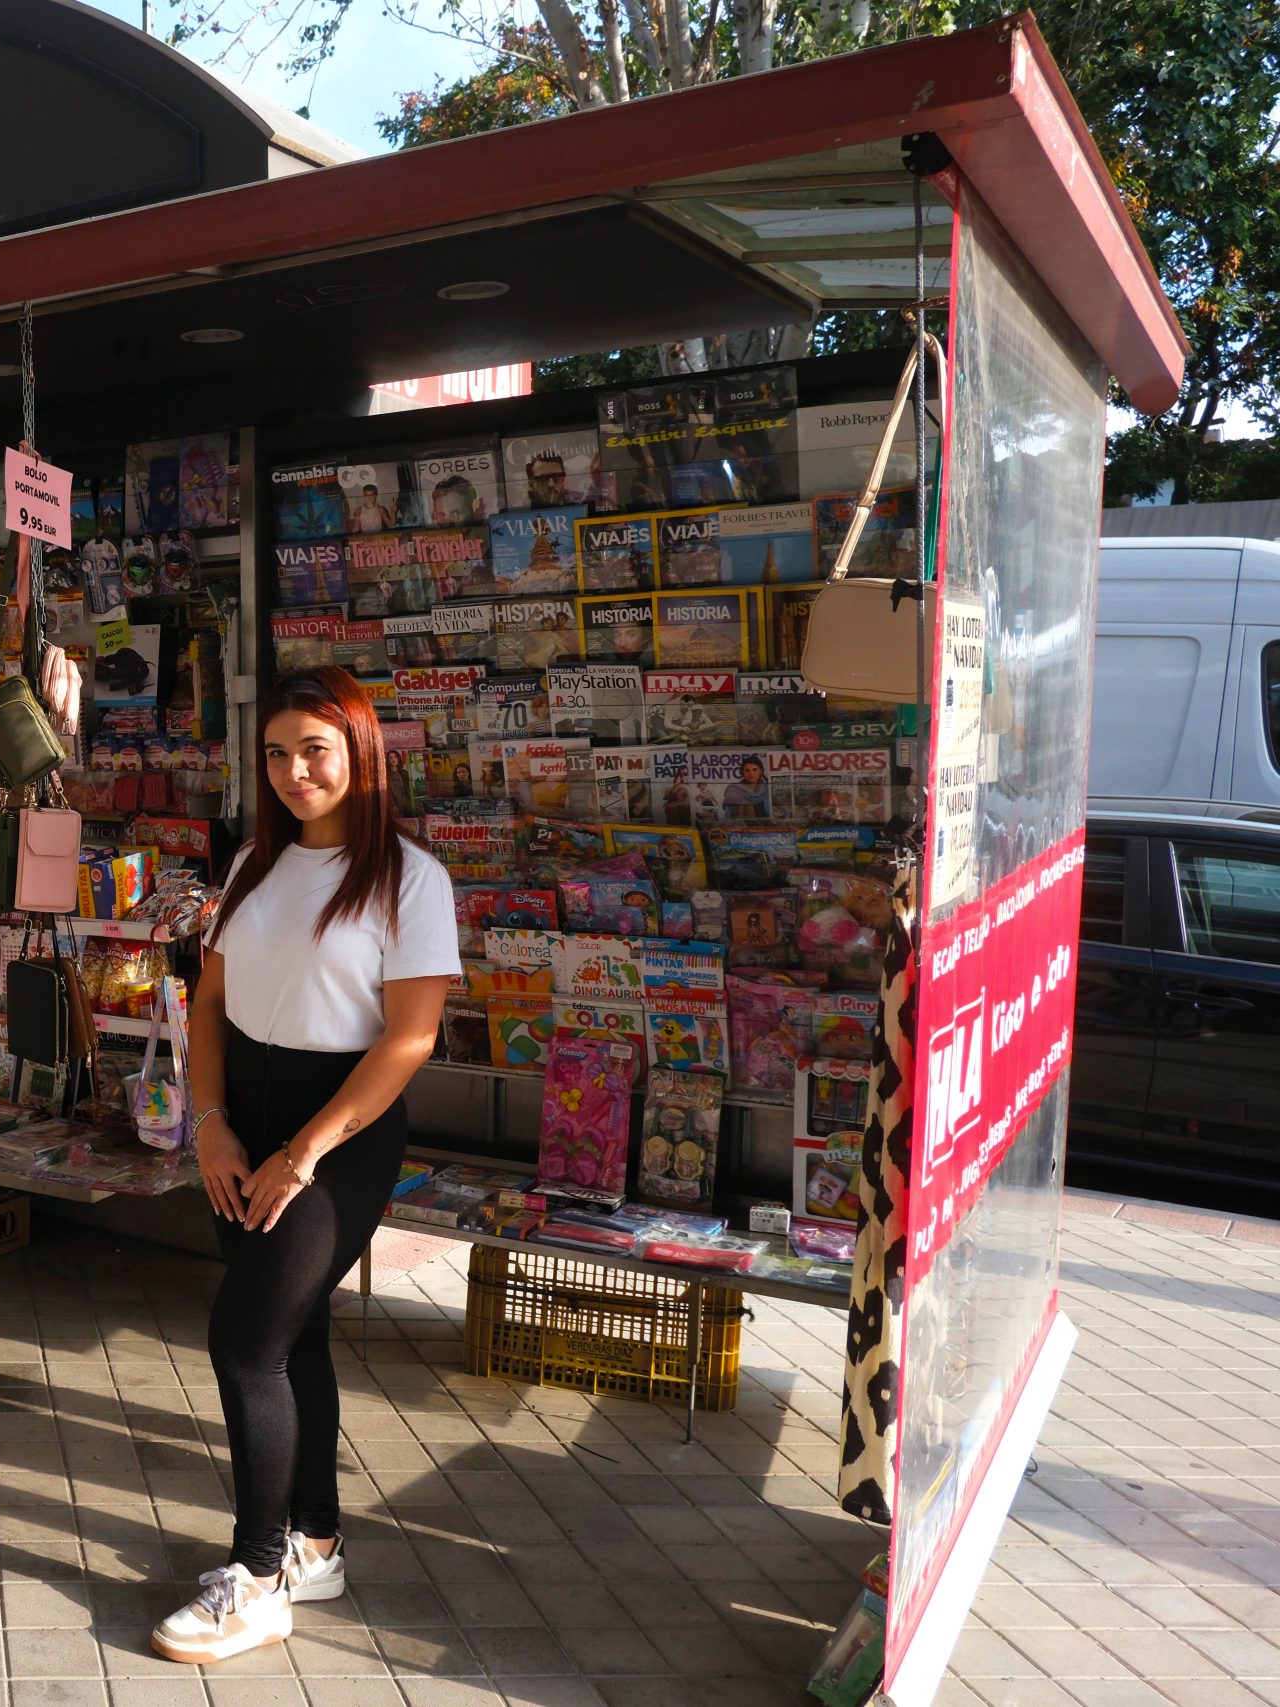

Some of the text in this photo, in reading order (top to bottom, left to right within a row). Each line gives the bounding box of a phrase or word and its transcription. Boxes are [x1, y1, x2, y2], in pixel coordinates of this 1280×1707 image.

[730, 391, 755, 400] BOSS
[638, 402, 660, 411] BOSS
[694, 418, 790, 438] Esquire
[820, 416, 851, 429] Robb
[25, 466, 47, 482] BOLSO
[271, 466, 336, 483] Cannabis
[419, 457, 490, 476] FORBES
[337, 464, 378, 488] GQ
[20, 507, 56, 536] 9,95 EUR
[723, 513, 766, 525] FORBES
[769, 508, 812, 522] TRAVEL
[504, 516, 569, 536] VIAJAR
[589, 525, 650, 546] VIAJES
[275, 546, 339, 565] VIAJES
[434, 609, 483, 621] HISTORIA
[494, 602, 575, 622] HISTORIA
[592, 607, 652, 624] HISTORIA
[667, 605, 731, 621] HISTORIA
[434, 620, 470, 631] Y VIDA
[947, 614, 960, 636] HAY
[953, 643, 982, 669] NAVIDAD
[394, 667, 478, 691] Gadget
[548, 675, 636, 694] PlayStation
[648, 674, 728, 691] muy
[479, 683, 537, 695] Computer
[397, 695, 449, 705] iPhone Air
[499, 703, 528, 729] 70
[501, 729, 528, 738] TRUCOS
[832, 726, 844, 737] 2
[526, 743, 565, 757] katia
[596, 755, 622, 770] PAT
[792, 752, 886, 771] LABORES
[692, 767, 743, 780] PUNTO
[946, 790, 972, 818] NAVIDAD
[730, 834, 795, 846] playmobil
[807, 829, 858, 840] playmobil
[510, 893, 546, 907] Disney
[500, 943, 552, 958] Colorea
[645, 957, 684, 969] PINTAR
[681, 970, 717, 980] NÚMEROS
[574, 986, 642, 999] DINOSAURIO
[572, 1003, 596, 1011] Educa
[655, 1003, 705, 1015] MOSAICO
[840, 996, 876, 1013] Piny
[564, 1010, 635, 1031] COLOR
[105, 1033, 146, 1043] MODA
